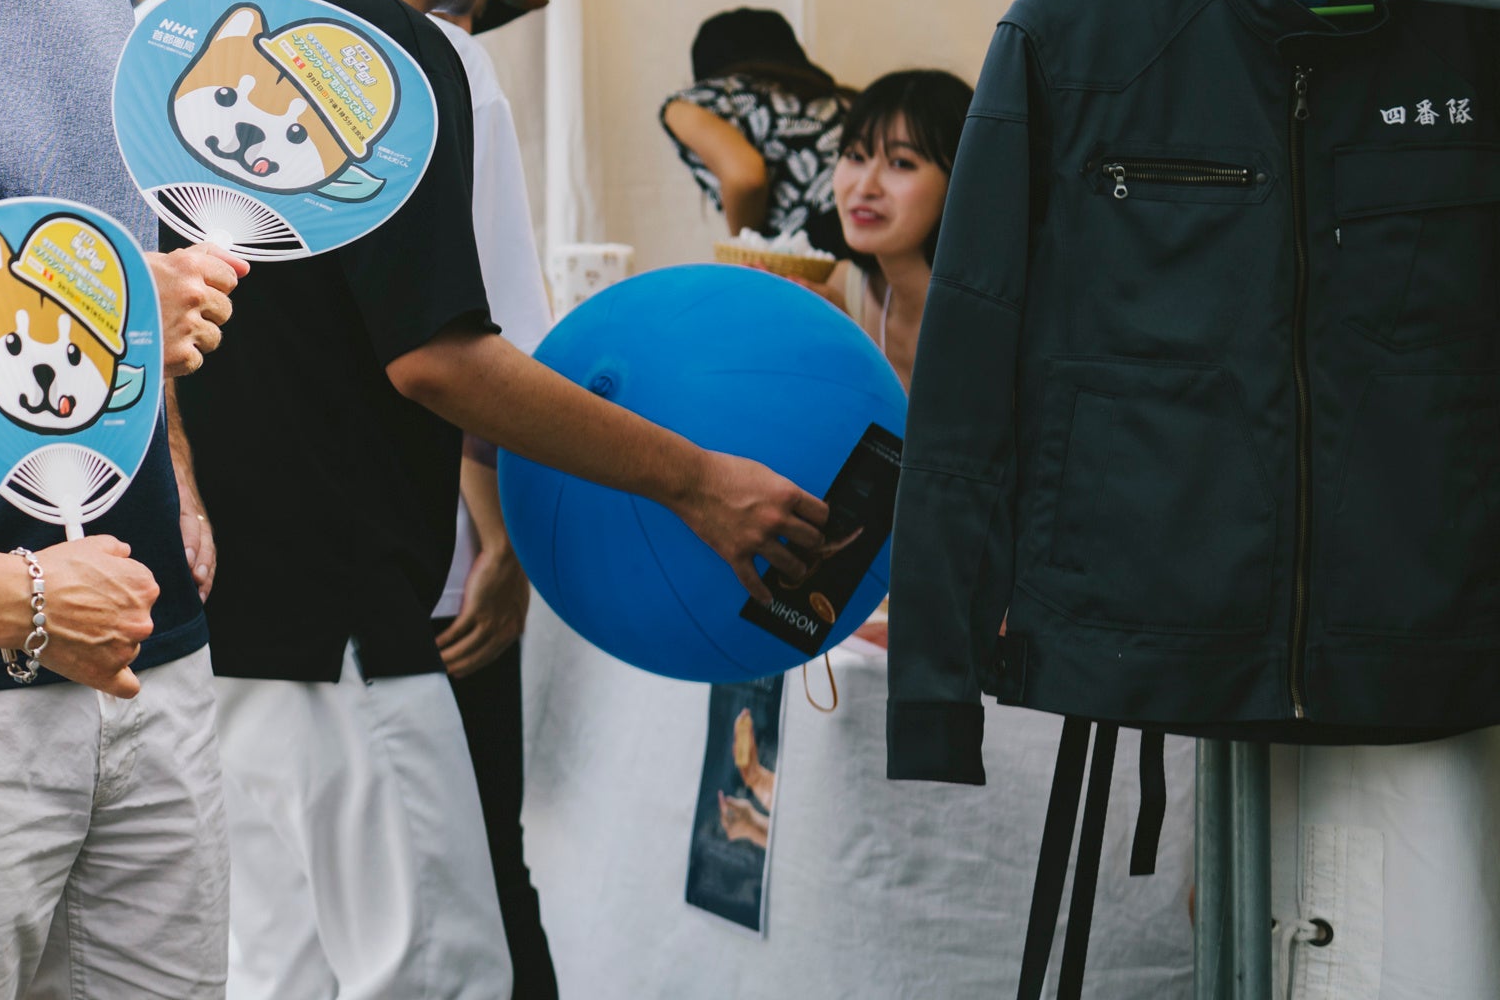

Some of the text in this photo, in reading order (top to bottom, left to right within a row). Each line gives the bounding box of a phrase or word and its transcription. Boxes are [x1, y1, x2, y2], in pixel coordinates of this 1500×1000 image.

[158, 18, 198, 39] NHK
[1379, 97, 1474, 126] 四番隊
